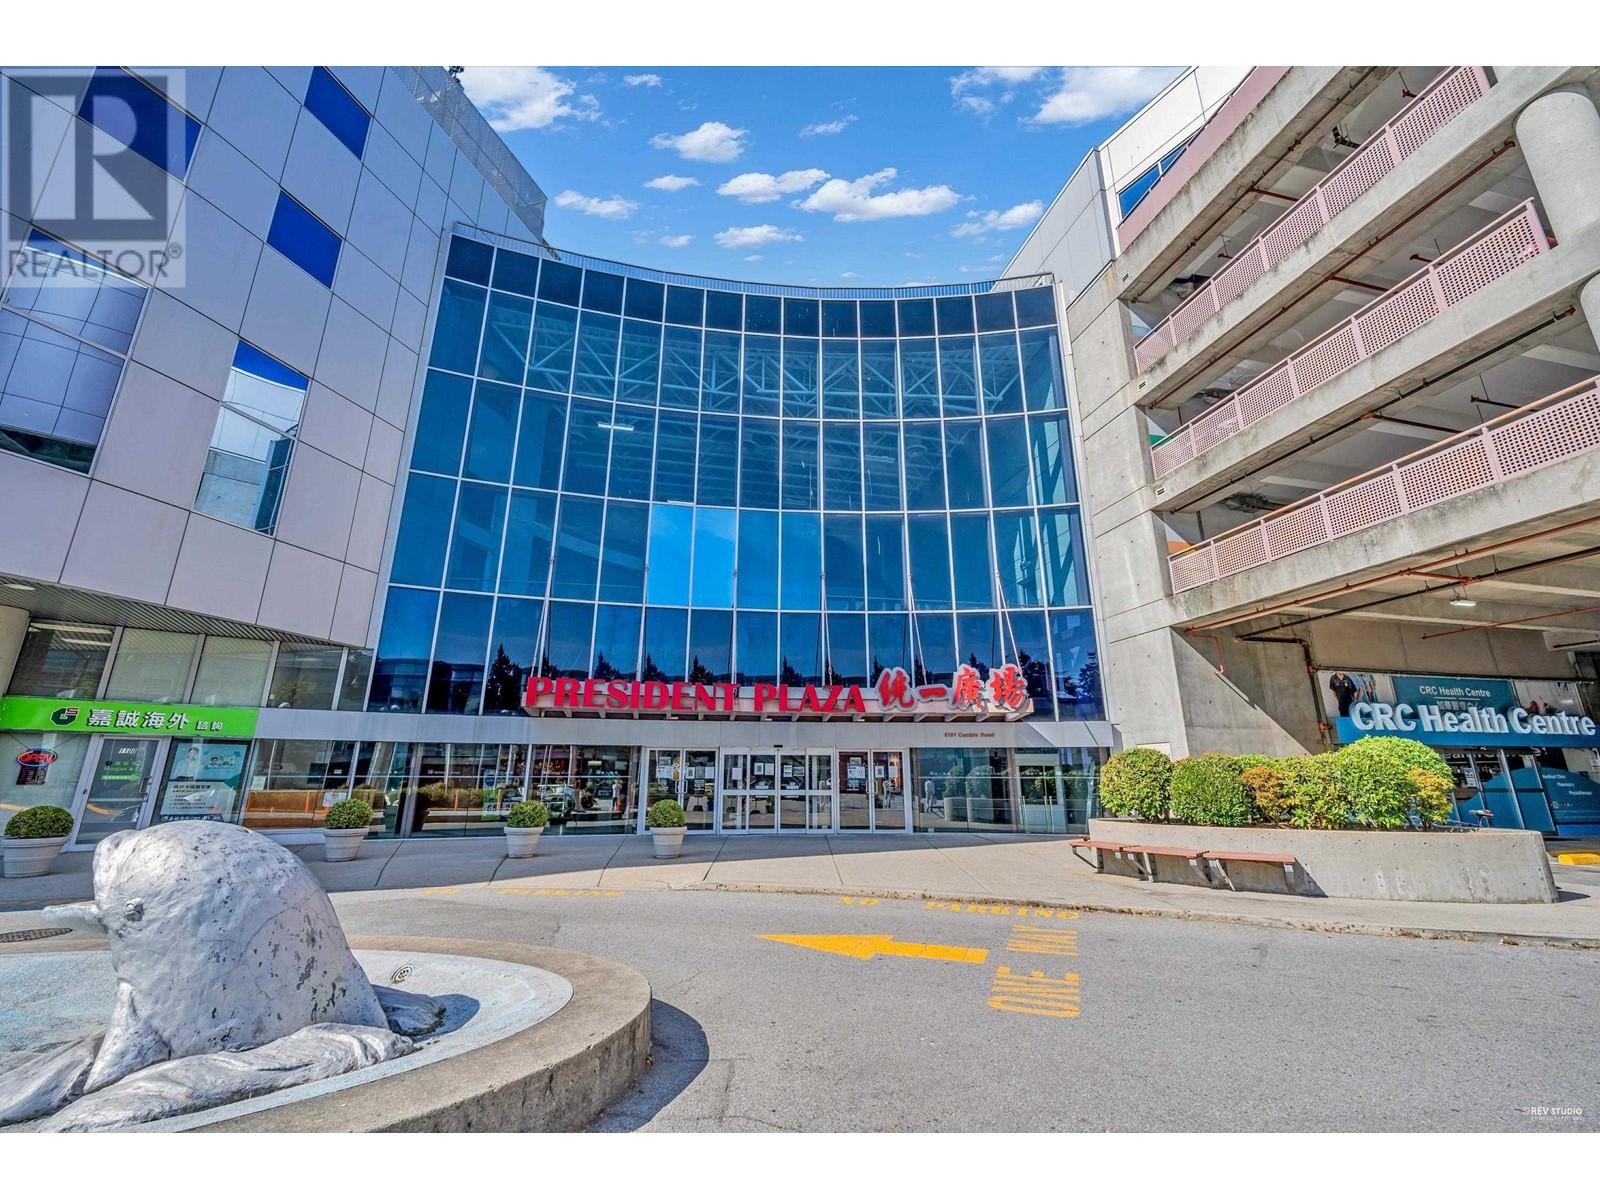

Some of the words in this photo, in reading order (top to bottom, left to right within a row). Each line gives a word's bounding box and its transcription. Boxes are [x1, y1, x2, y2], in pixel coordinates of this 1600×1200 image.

[526, 677, 740, 711] PRESIDENT
[754, 683, 866, 713] PLAZA
[1419, 685, 1438, 695] CRC
[1439, 686, 1465, 696] Health
[1465, 687, 1491, 697] Centre
[88, 708, 189, 729] 嘉誠海外
[1351, 702, 1416, 731] CRC
[1417, 704, 1509, 733] Health
[1510, 707, 1596, 736] Centre
[22, 752, 54, 763] OPEN
